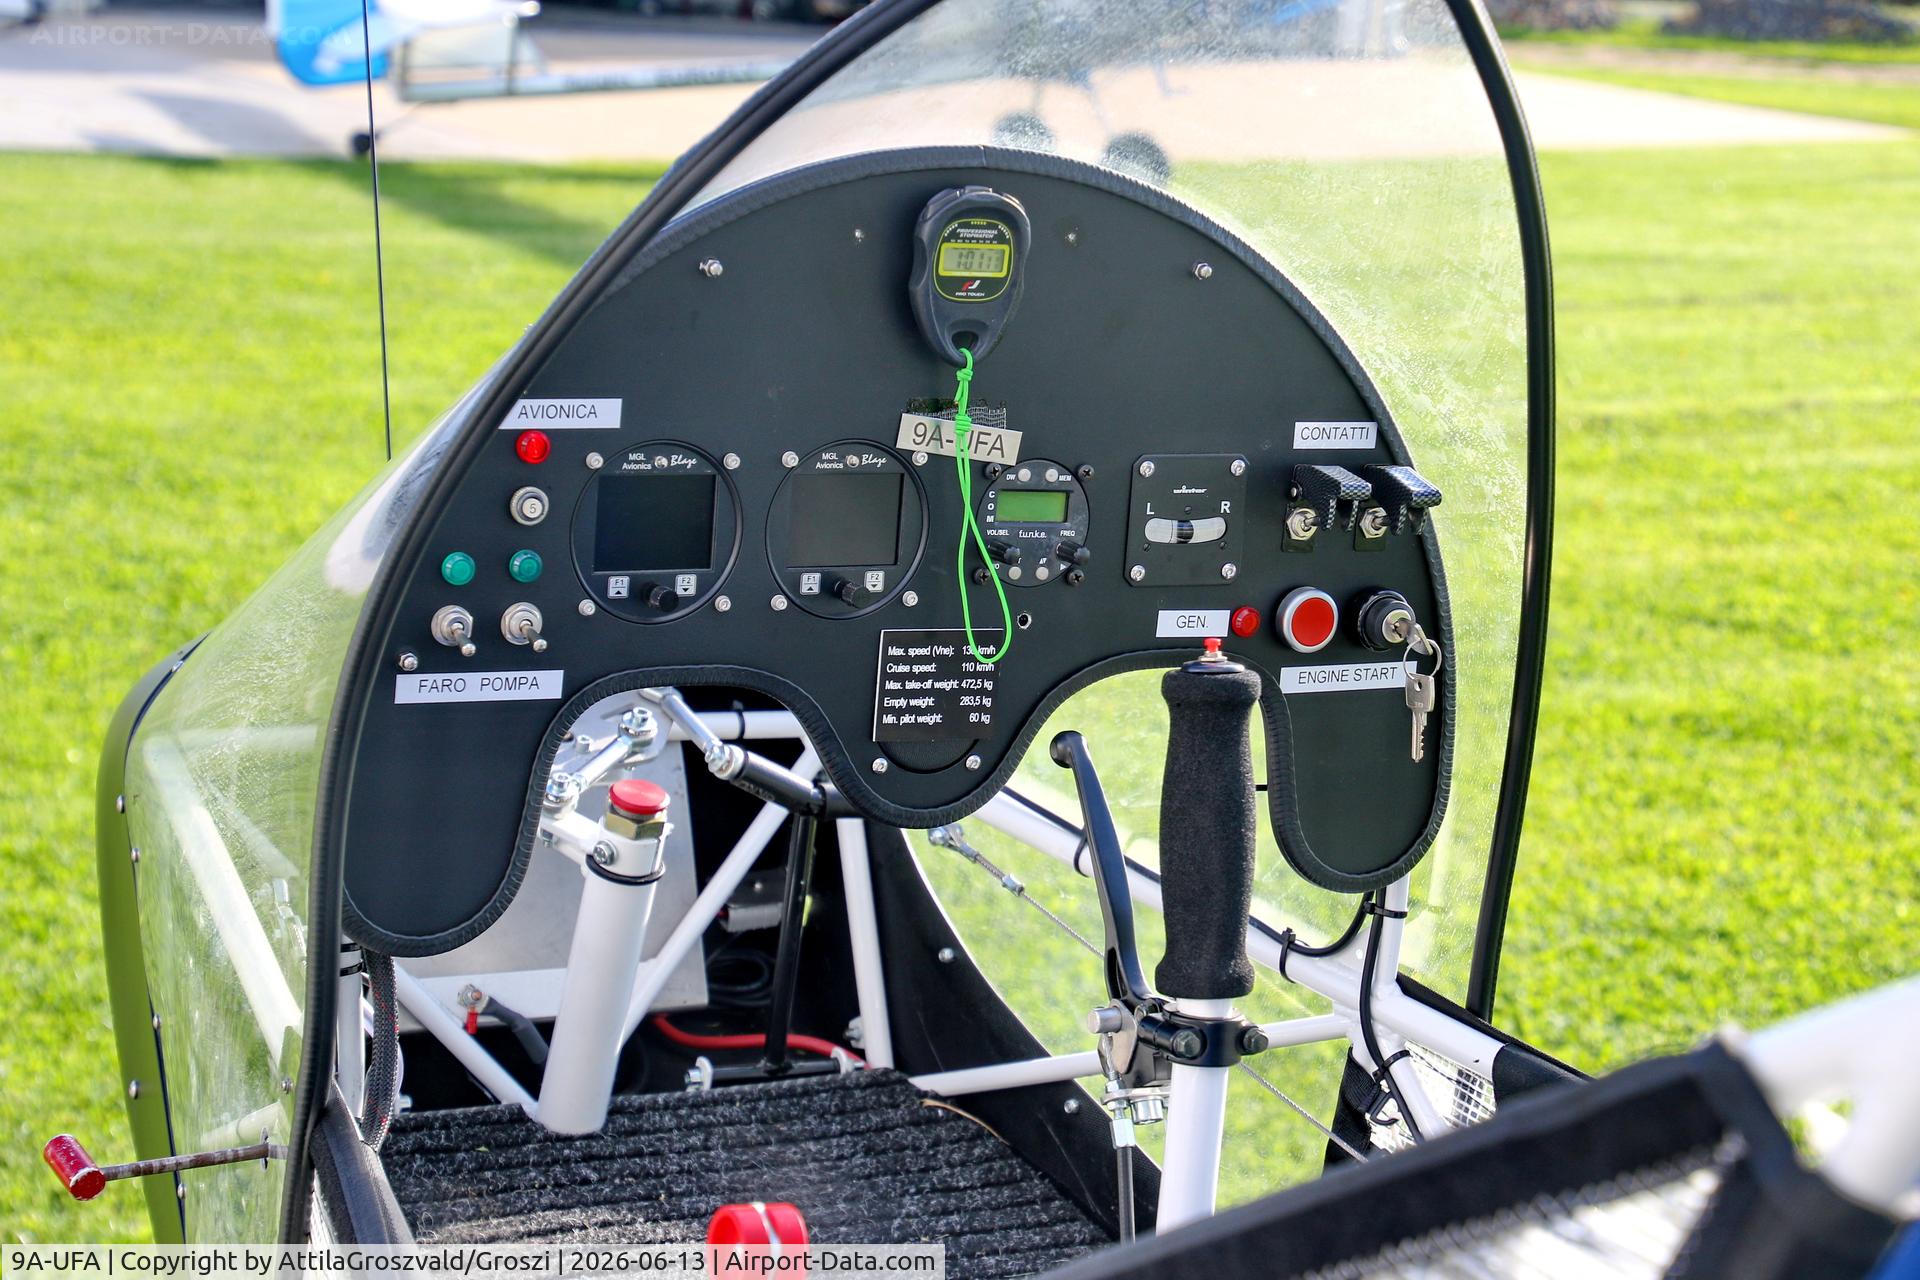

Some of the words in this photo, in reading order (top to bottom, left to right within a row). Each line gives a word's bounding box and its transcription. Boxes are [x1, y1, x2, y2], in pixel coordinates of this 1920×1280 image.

[518, 403, 598, 419] AVIONICA
[1300, 426, 1370, 441] CONTATTI
[628, 452, 647, 461] MGL
[670, 454, 698, 469] Blaze
[821, 452, 839, 460] MGL
[861, 453, 888, 468] Blaze
[621, 462, 652, 470] Avionics
[815, 461, 844, 469] Avionics
[1006, 473, 1016, 481] DW
[529, 503, 537, 514] 5
[1146, 502, 1155, 515] L
[1220, 500, 1231, 514] R
[1060, 529, 1076, 537] FREQ
[614, 578, 625, 587] F1
[681, 576, 692, 585] F2
[806, 575, 817, 583] F1
[870, 573, 880, 581] F2
[1176, 614, 1209, 629] GEN.
[888, 646, 906, 656] Max.
[907, 645, 931, 657] speed
[932, 645, 955, 657] (Vne):
[977, 645, 996, 655] km/h
[886, 663, 910, 673] Cruise
[911, 662, 937, 674] speed:
[961, 662, 975, 672] 110
[976, 661, 995, 672] km/h
[1298, 669, 1350, 684] ENGINE
[1353, 666, 1398, 682] START
[418, 677, 467, 694] FARO
[479, 676, 540, 692] POMPA
[885, 680, 903, 690] Max.
[905, 679, 933, 689] take-off
[933, 679, 959, 691] weight:
[961, 679, 982, 690] 472,5
[983, 679, 994, 691] kg
[883, 697, 908, 709] Empty
[909, 696, 935, 708] weight:
[959, 696, 981, 706] 283,5
[982, 696, 992, 707] kg
[882, 714, 898, 724] Min.
[899, 714, 915, 725] pilot
[917, 713, 943, 725] weight:
[969, 712, 979, 723] 60
[980, 712, 991, 724] kg
